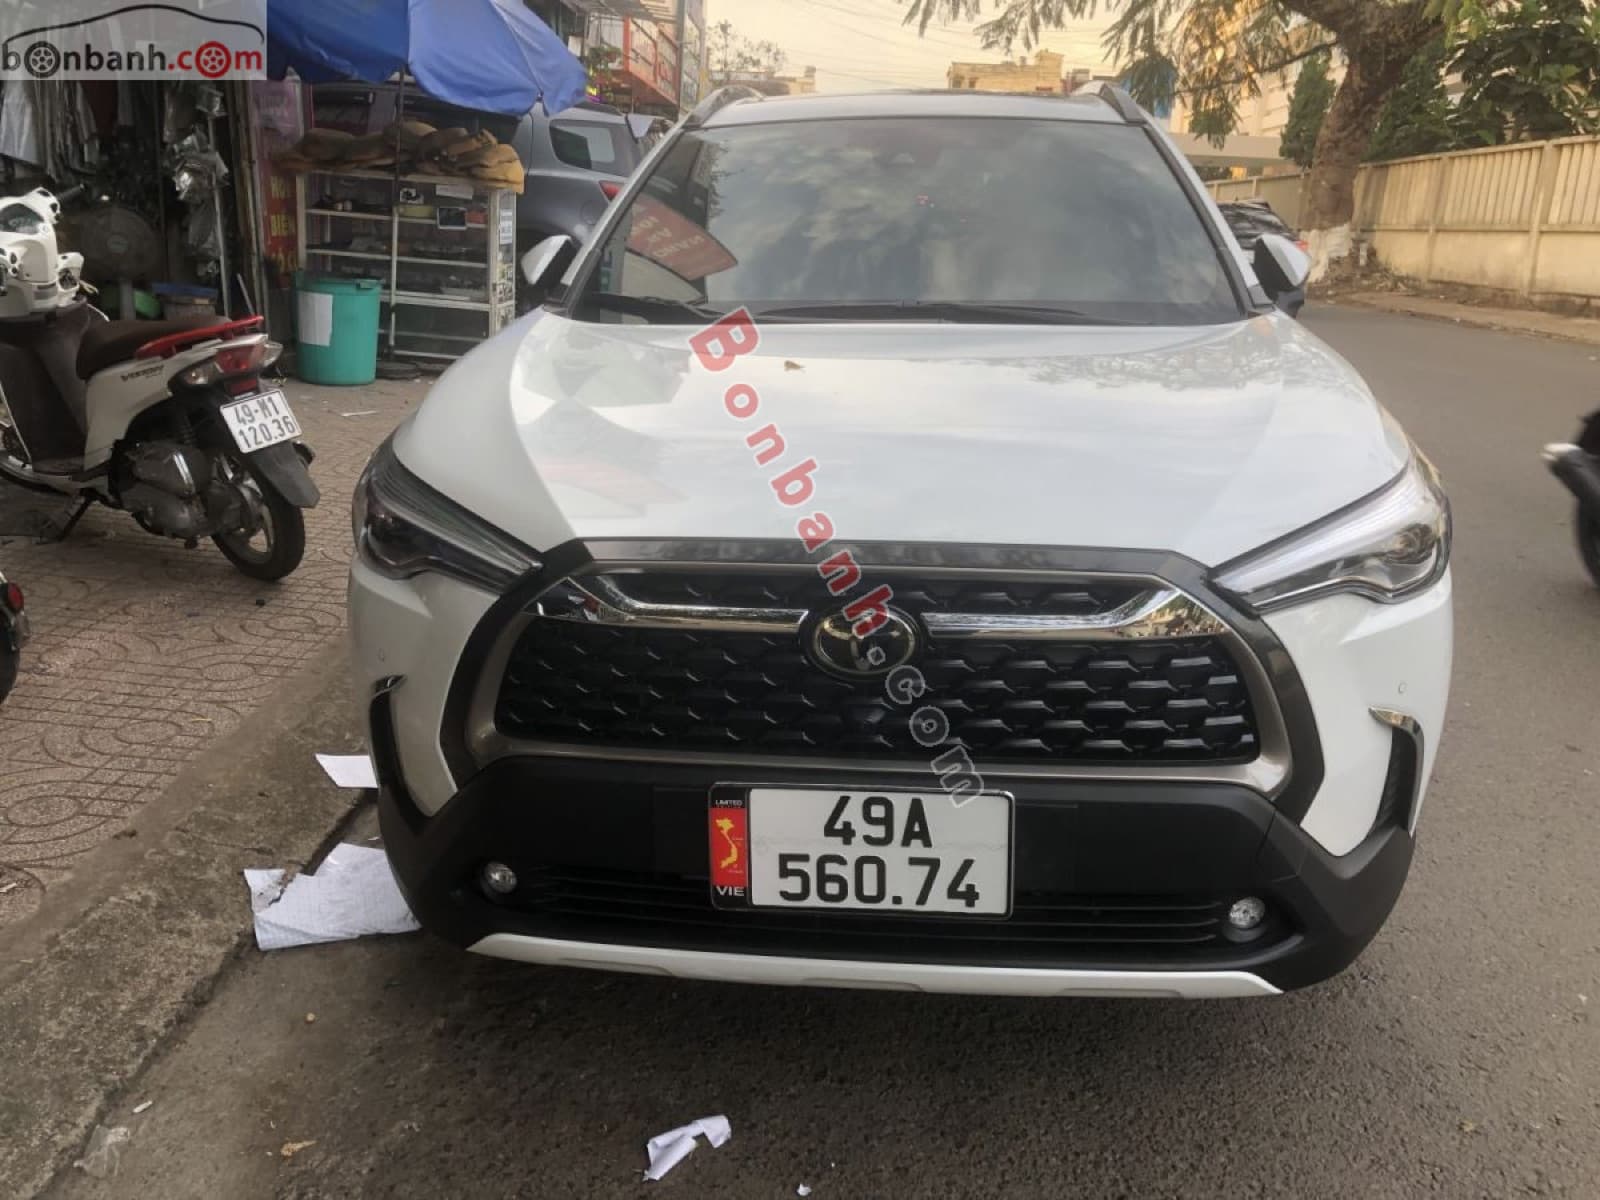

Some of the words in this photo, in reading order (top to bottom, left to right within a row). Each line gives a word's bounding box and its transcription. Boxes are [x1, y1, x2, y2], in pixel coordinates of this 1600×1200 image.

[238, 415, 296, 448] 120.36
[823, 795, 933, 848] 49A
[715, 885, 745, 897] VIE
[778, 853, 980, 908] 560.74
